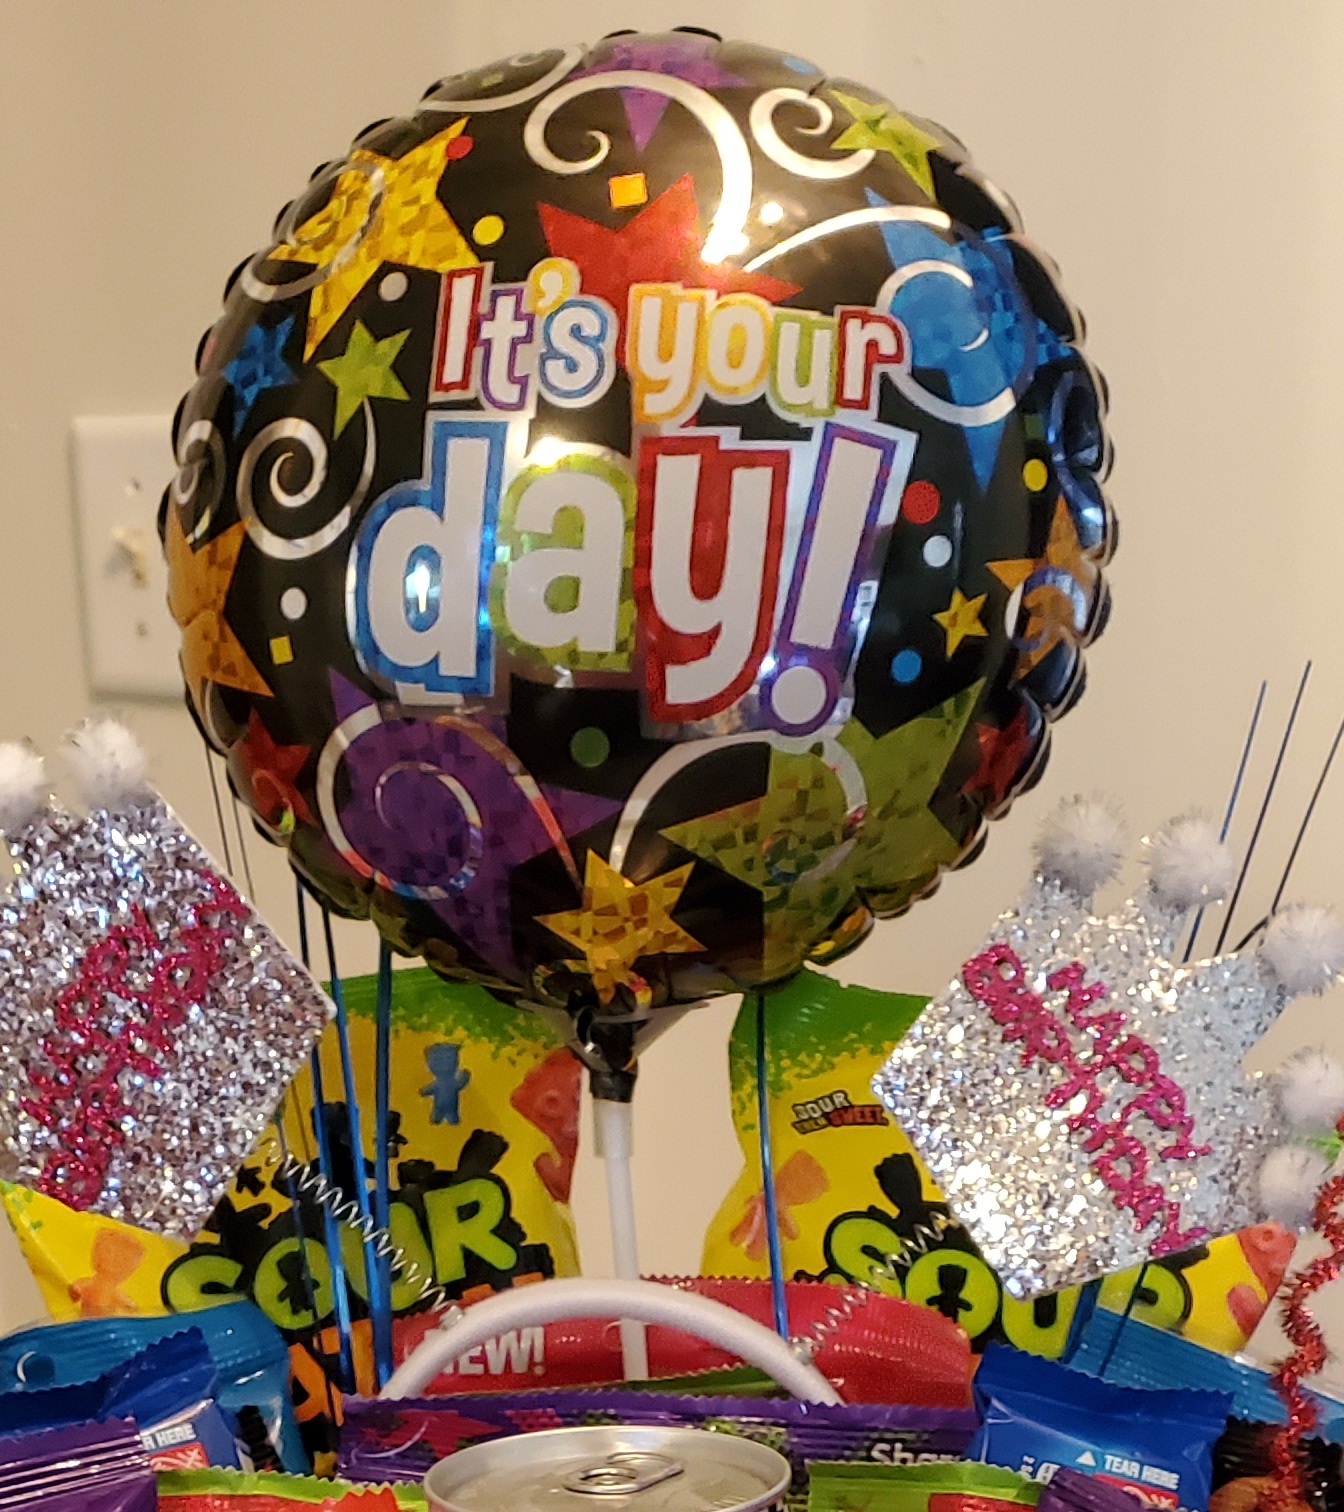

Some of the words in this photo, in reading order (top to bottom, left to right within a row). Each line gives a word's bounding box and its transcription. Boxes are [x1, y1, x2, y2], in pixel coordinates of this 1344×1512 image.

[434, 258, 613, 412] It's
[628, 283, 908, 422] your
[351, 418, 904, 738] day!
[793, 1092, 851, 1120] SOUR
[1047, 958, 1211, 1156] HAPPY
[167, 1177, 518, 1330] SOUR
[1103, 1454, 1139, 1478] TEAR
